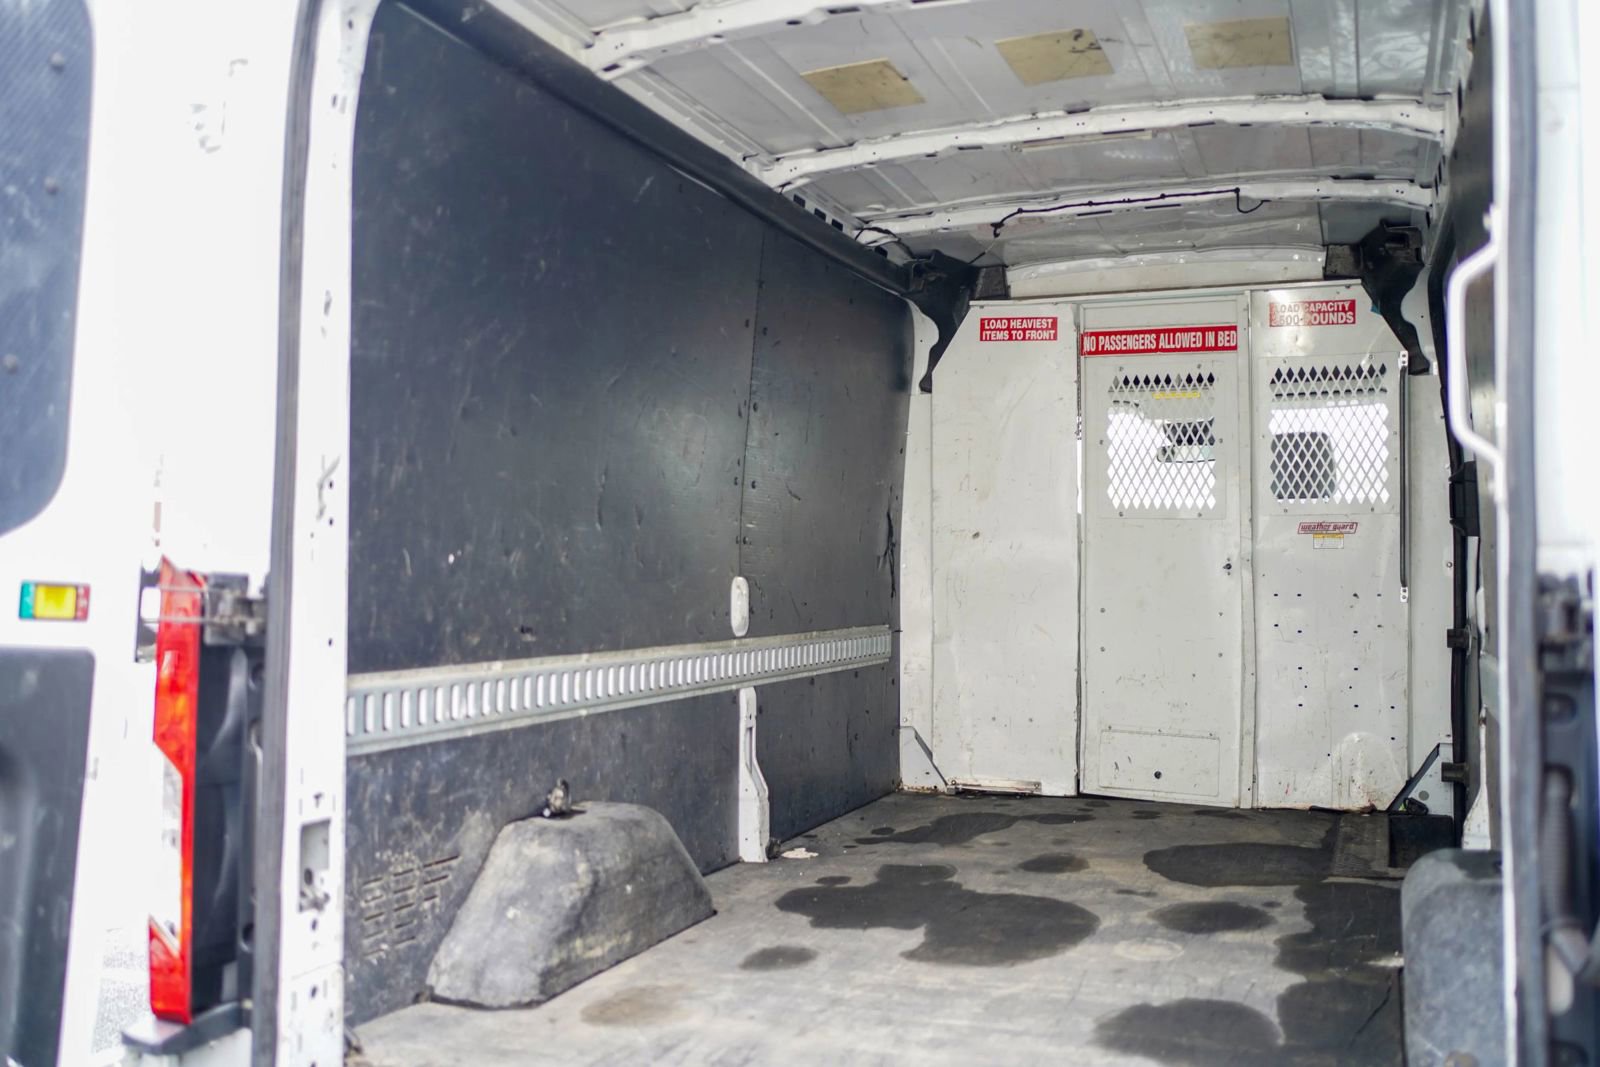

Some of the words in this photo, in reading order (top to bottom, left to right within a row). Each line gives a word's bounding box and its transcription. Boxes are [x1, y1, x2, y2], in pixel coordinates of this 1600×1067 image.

[1303, 302, 1350, 312] CAPACITY
[984, 320, 1008, 329] LOAD
[1010, 319, 1053, 329] HEAVIEST
[982, 330, 1009, 340] ITEMS
[1011, 330, 1024, 340] TO
[1025, 329, 1055, 340] FRONT
[1083, 335, 1097, 352] NO
[1098, 333, 1157, 351] PASSENGERS
[1159, 332, 1202, 349] ALLOWED
[1205, 331, 1215, 347] IN
[1217, 330, 1237, 347] BED
[1301, 522, 1331, 530] weather
